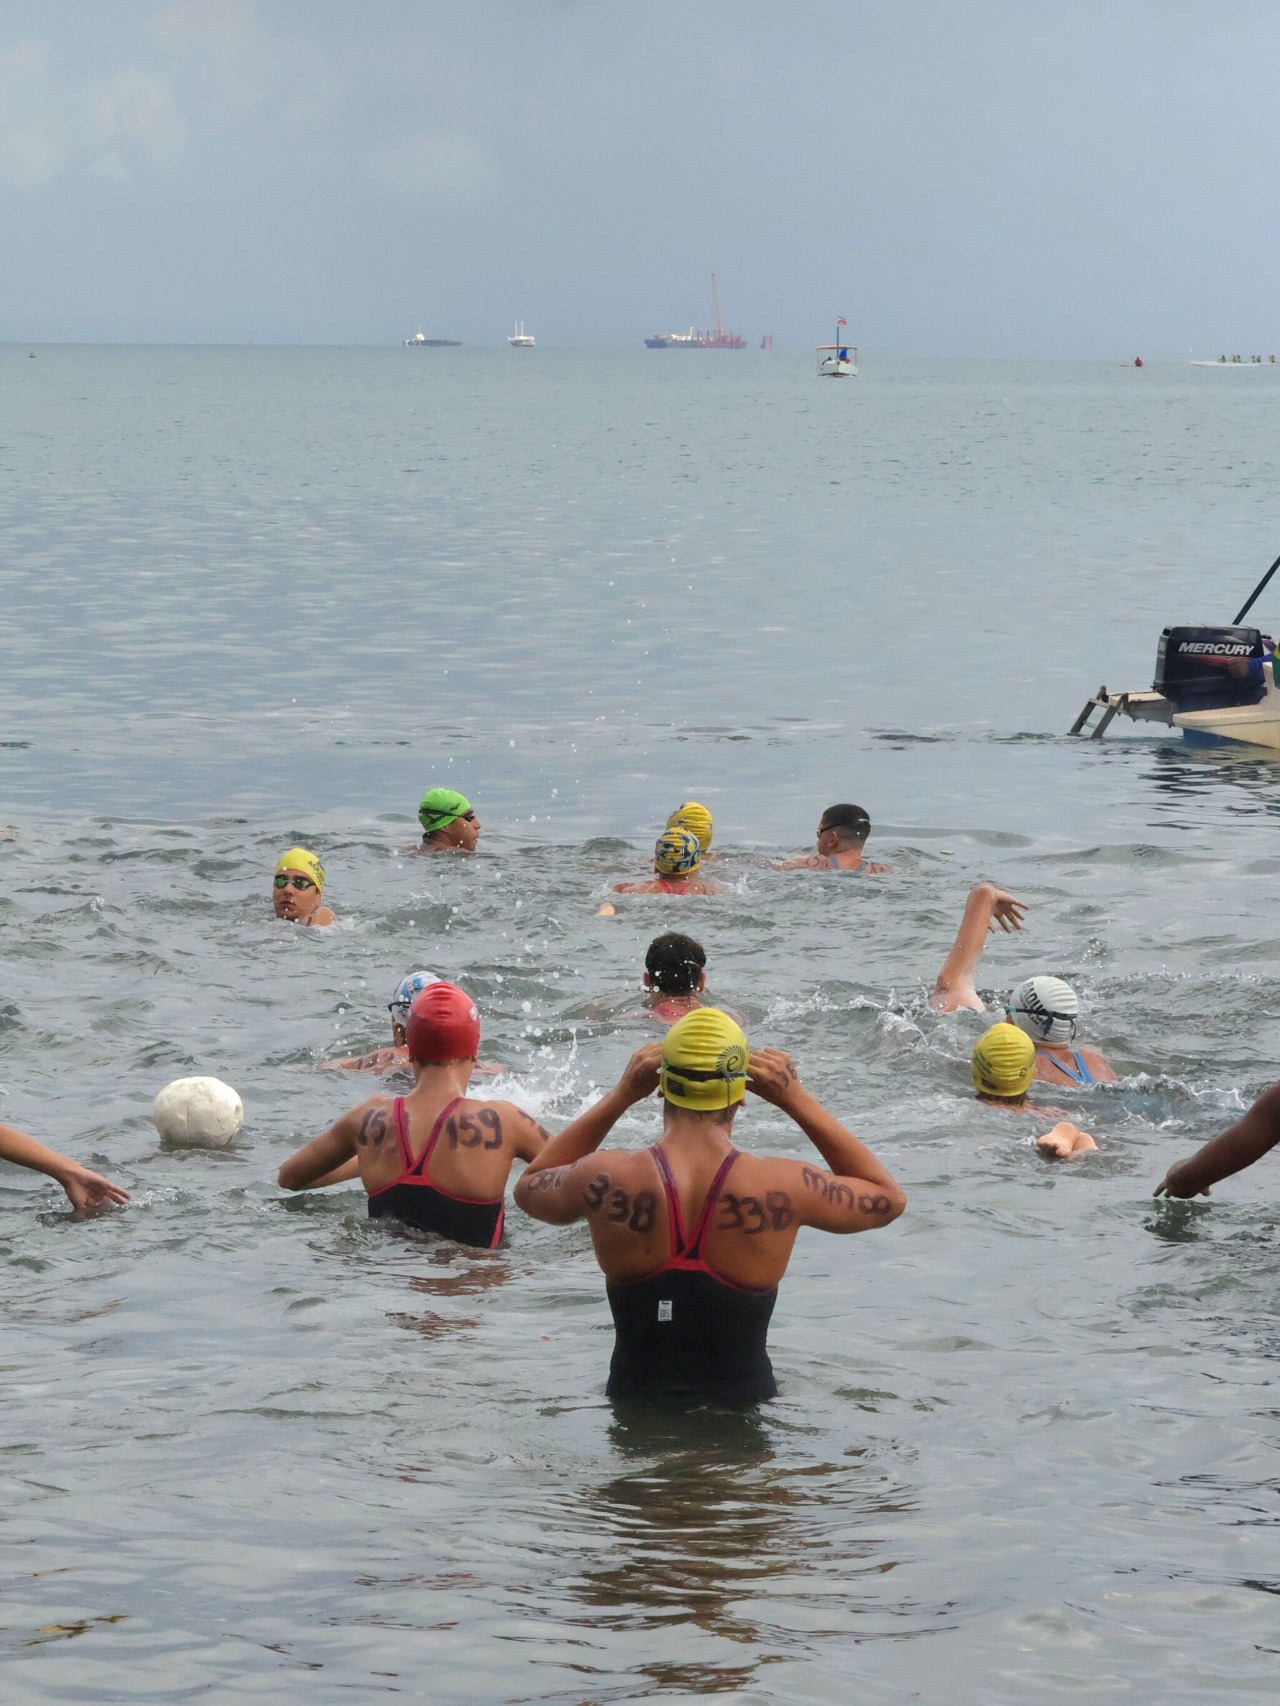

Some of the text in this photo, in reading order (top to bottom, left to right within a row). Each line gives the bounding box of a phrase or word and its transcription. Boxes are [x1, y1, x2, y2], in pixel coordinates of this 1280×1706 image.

[1178, 641, 1255, 656] MERCURY
[445, 1107, 503, 1150] 159
[583, 1173, 658, 1235] 338
[717, 1189, 797, 1236] 338
